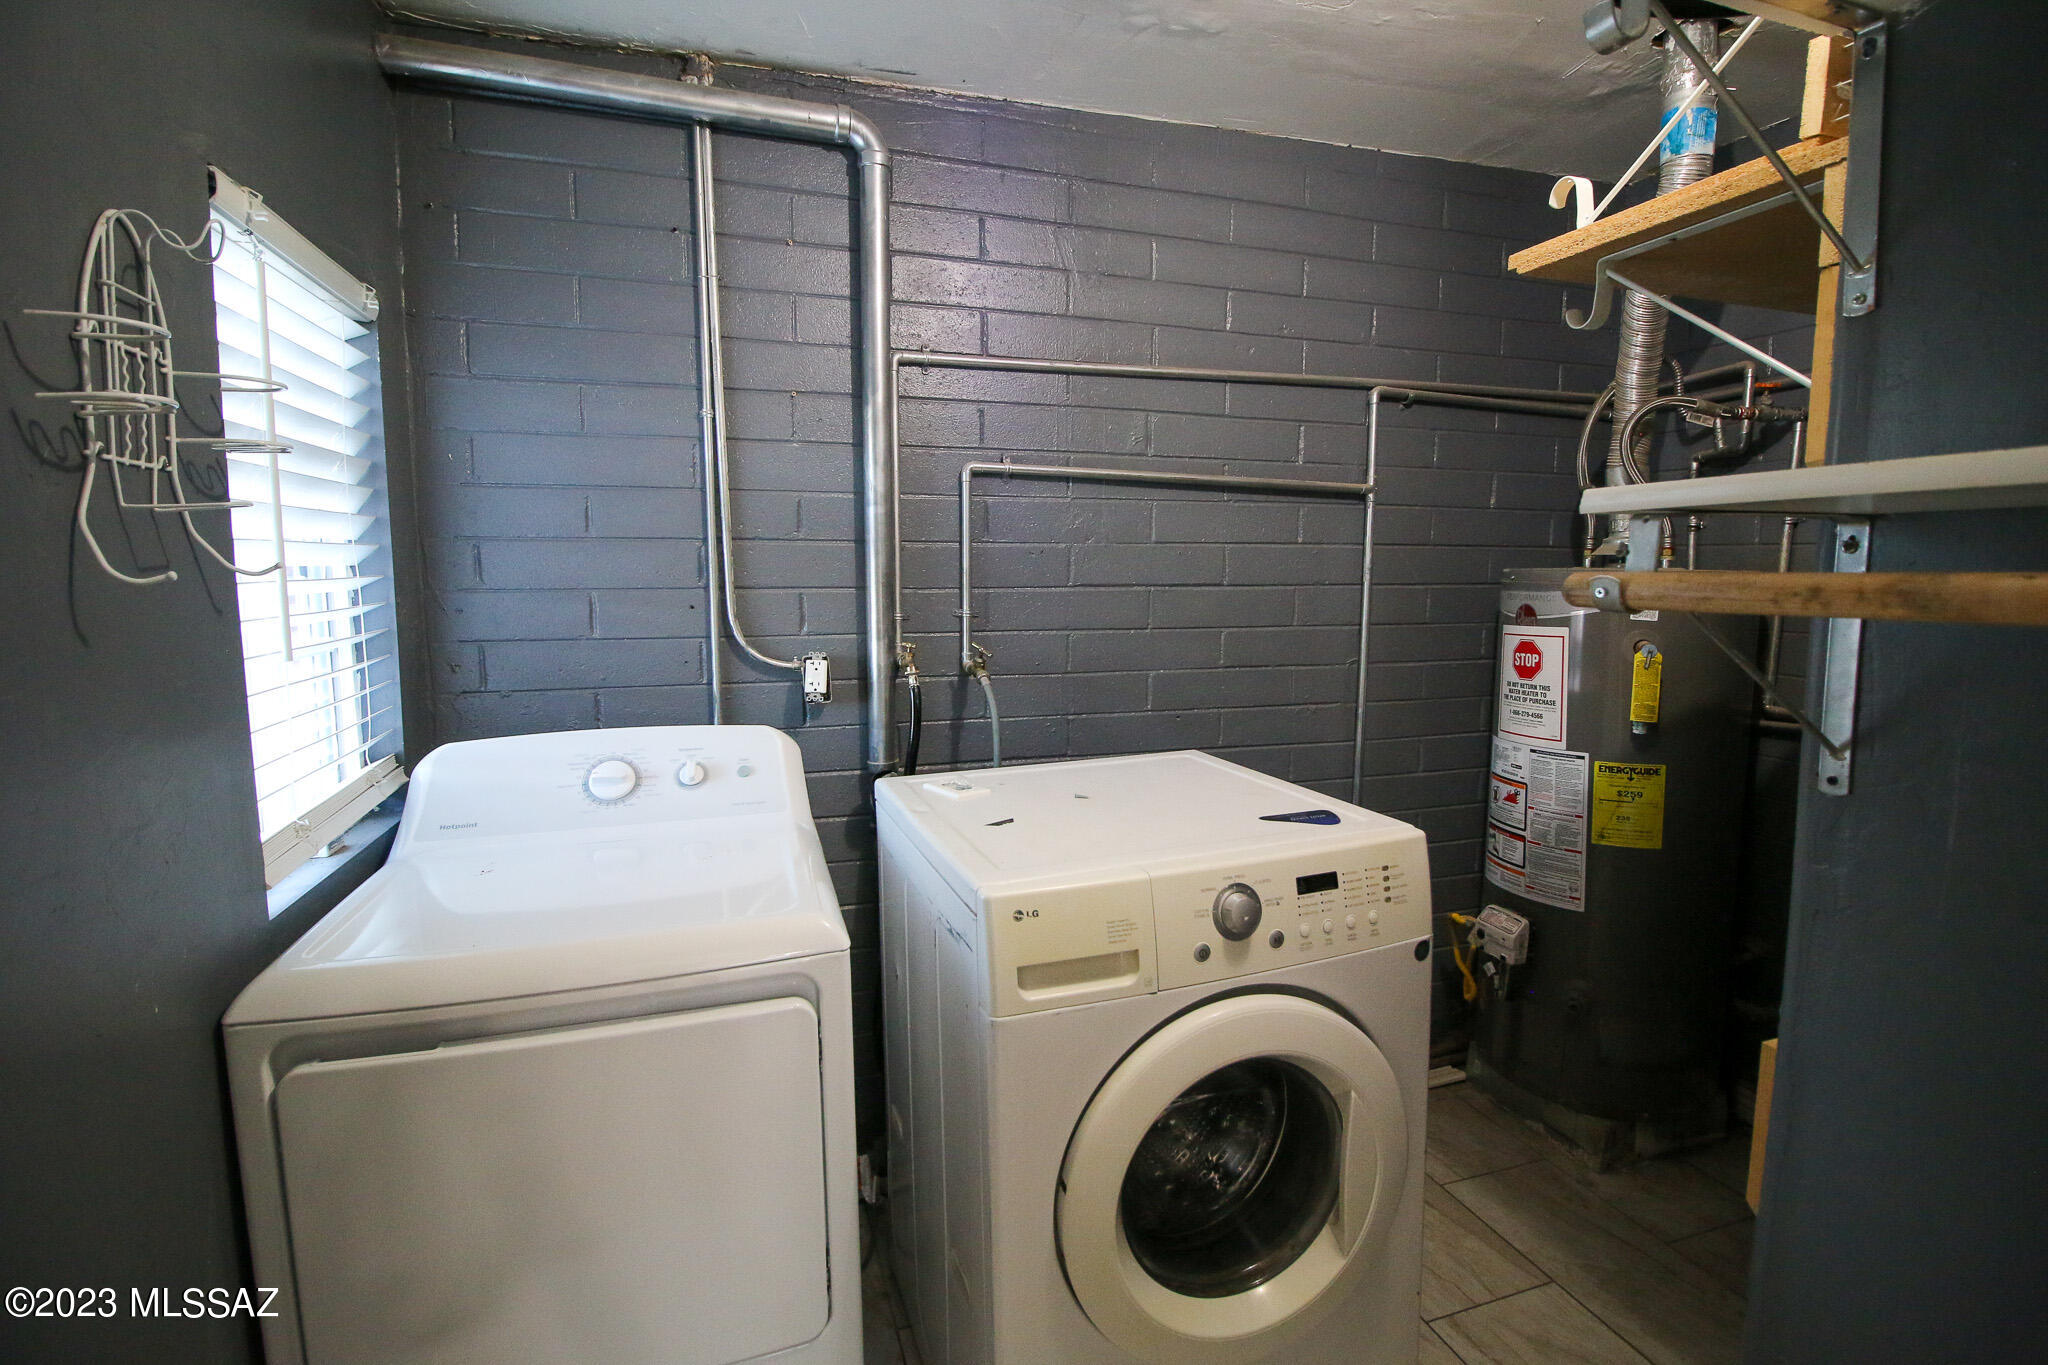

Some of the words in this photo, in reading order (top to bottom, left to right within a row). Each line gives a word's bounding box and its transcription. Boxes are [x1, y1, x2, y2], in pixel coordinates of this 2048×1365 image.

[1514, 652, 1539, 667] STOP
[1520, 682, 1537, 690] RETURN
[1521, 689, 1538, 697] HEATER
[1540, 691, 1547, 699] TO
[1510, 694, 1521, 702] PLACE
[1529, 697, 1557, 707] PURCHASE
[1598, 765, 1661, 776] ENERGYGUIDE
[1616, 790, 1643, 798] $259
[439, 821, 478, 831] Hotpoint
[1026, 909, 1039, 918] LG
